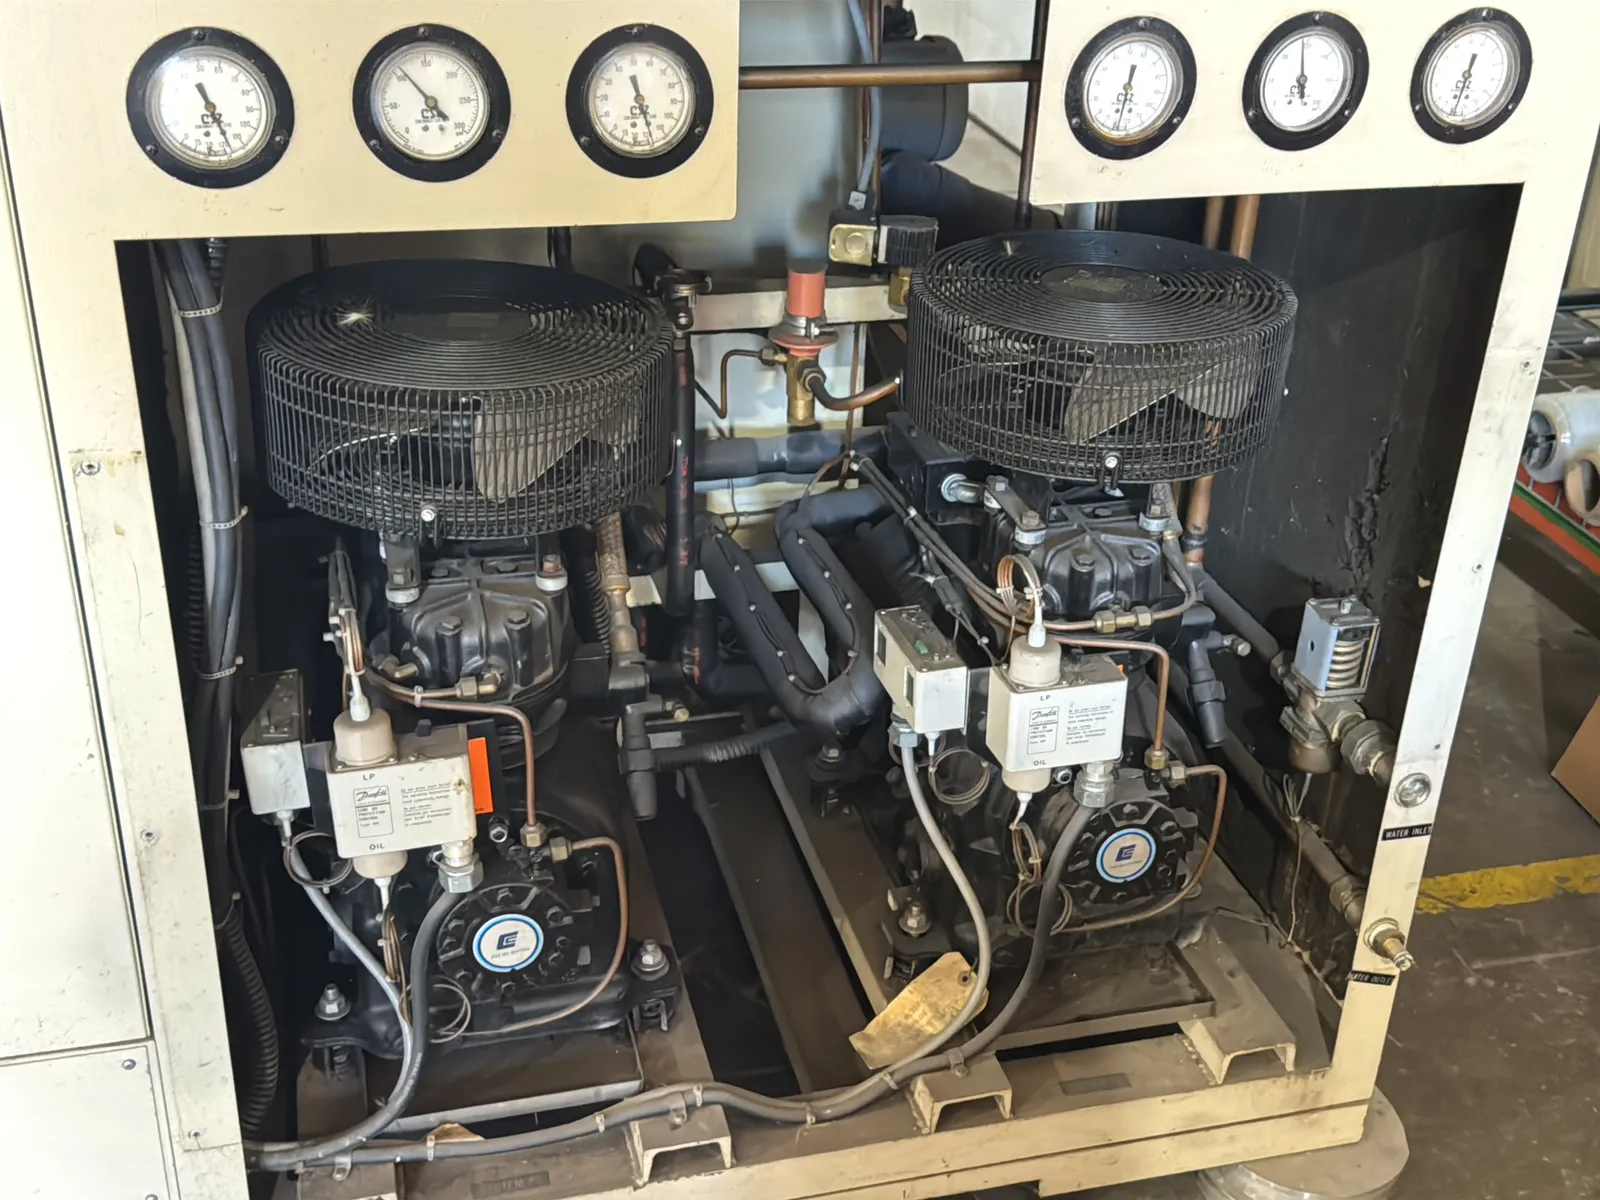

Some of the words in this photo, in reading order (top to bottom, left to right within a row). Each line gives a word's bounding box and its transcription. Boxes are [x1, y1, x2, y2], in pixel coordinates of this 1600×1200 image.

[363, 773, 375, 781] LP
[1386, 829, 1409, 838] WATER
[1412, 826, 1433, 835] INLET
[369, 843, 385, 851] OIL
